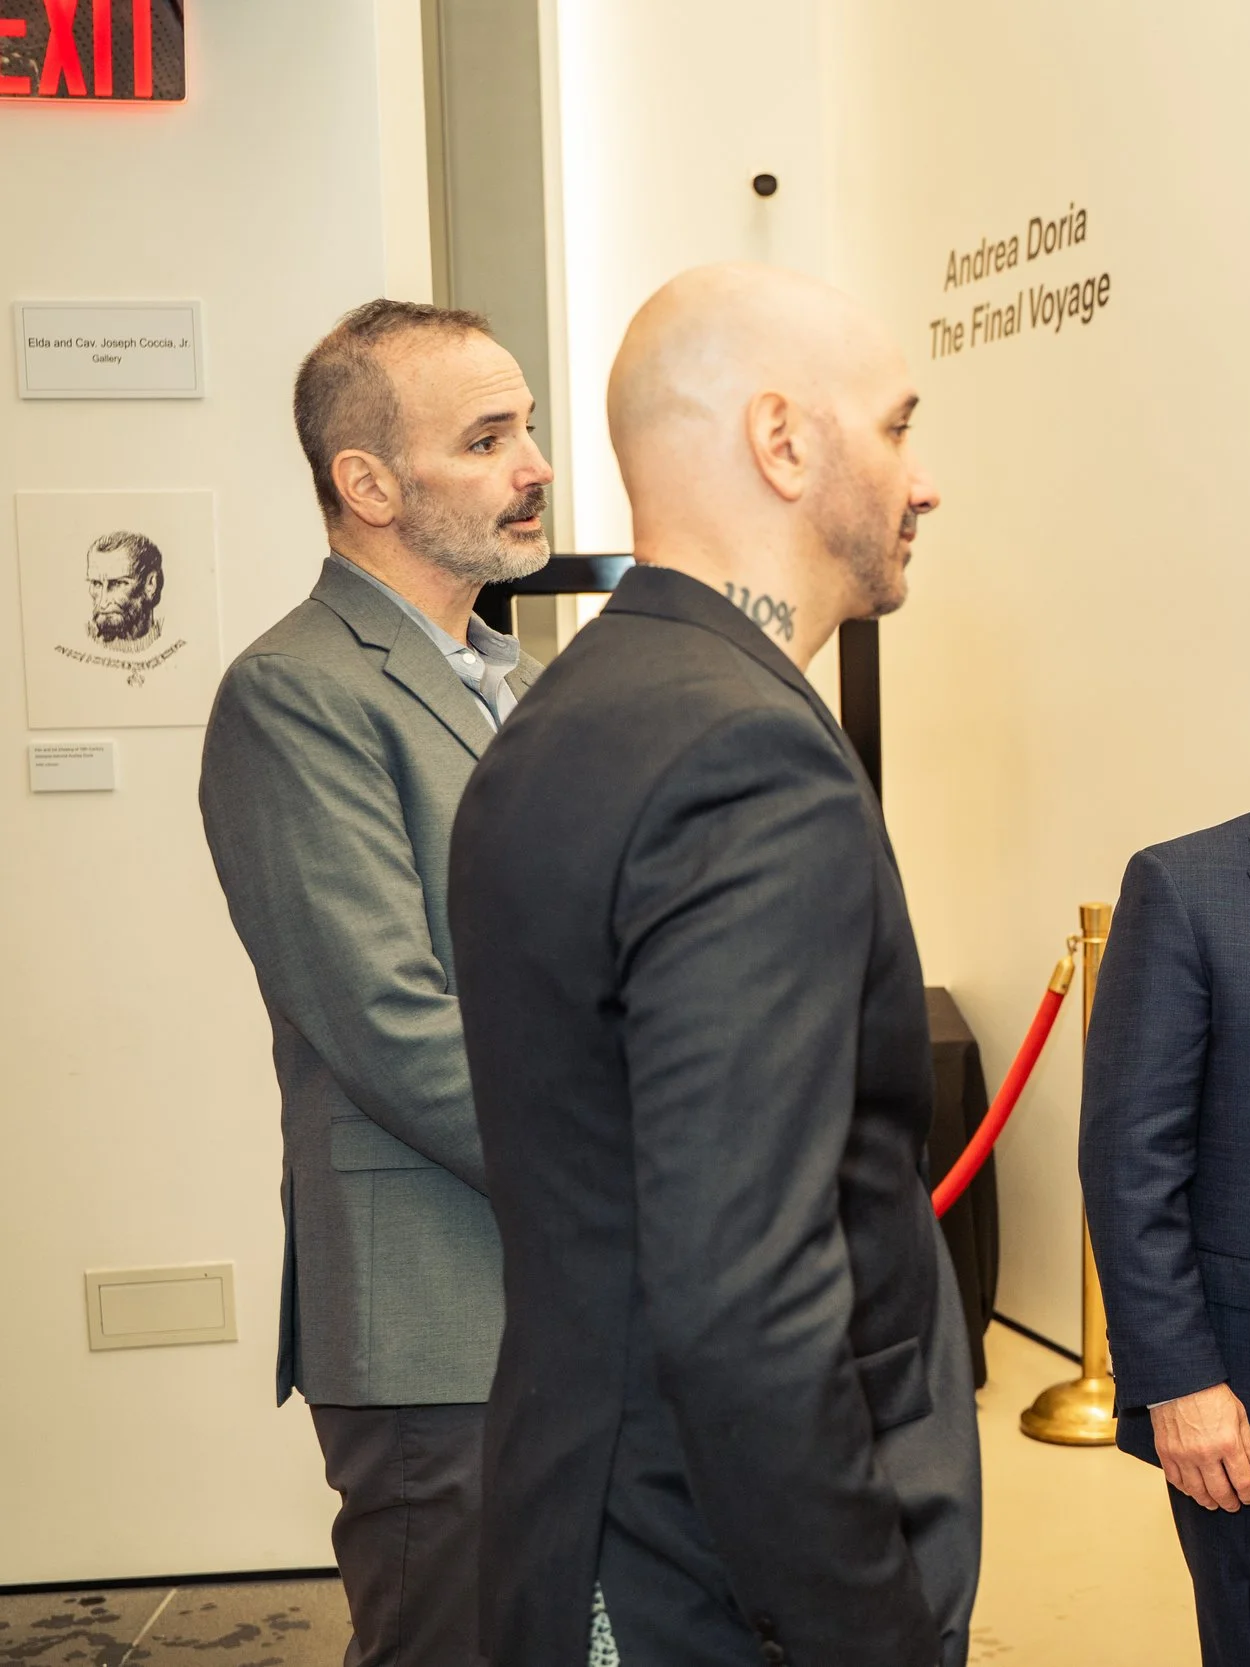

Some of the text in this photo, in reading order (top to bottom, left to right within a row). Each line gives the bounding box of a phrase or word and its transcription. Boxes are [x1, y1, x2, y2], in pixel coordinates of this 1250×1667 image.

[944, 201, 1087, 292] Andrea Doria
[930, 272, 1110, 360] The Final Voyage
[28, 337, 191, 350] Elda and Cav. Joseph Coccia, Jr.
[92, 354, 122, 364] Gallery
